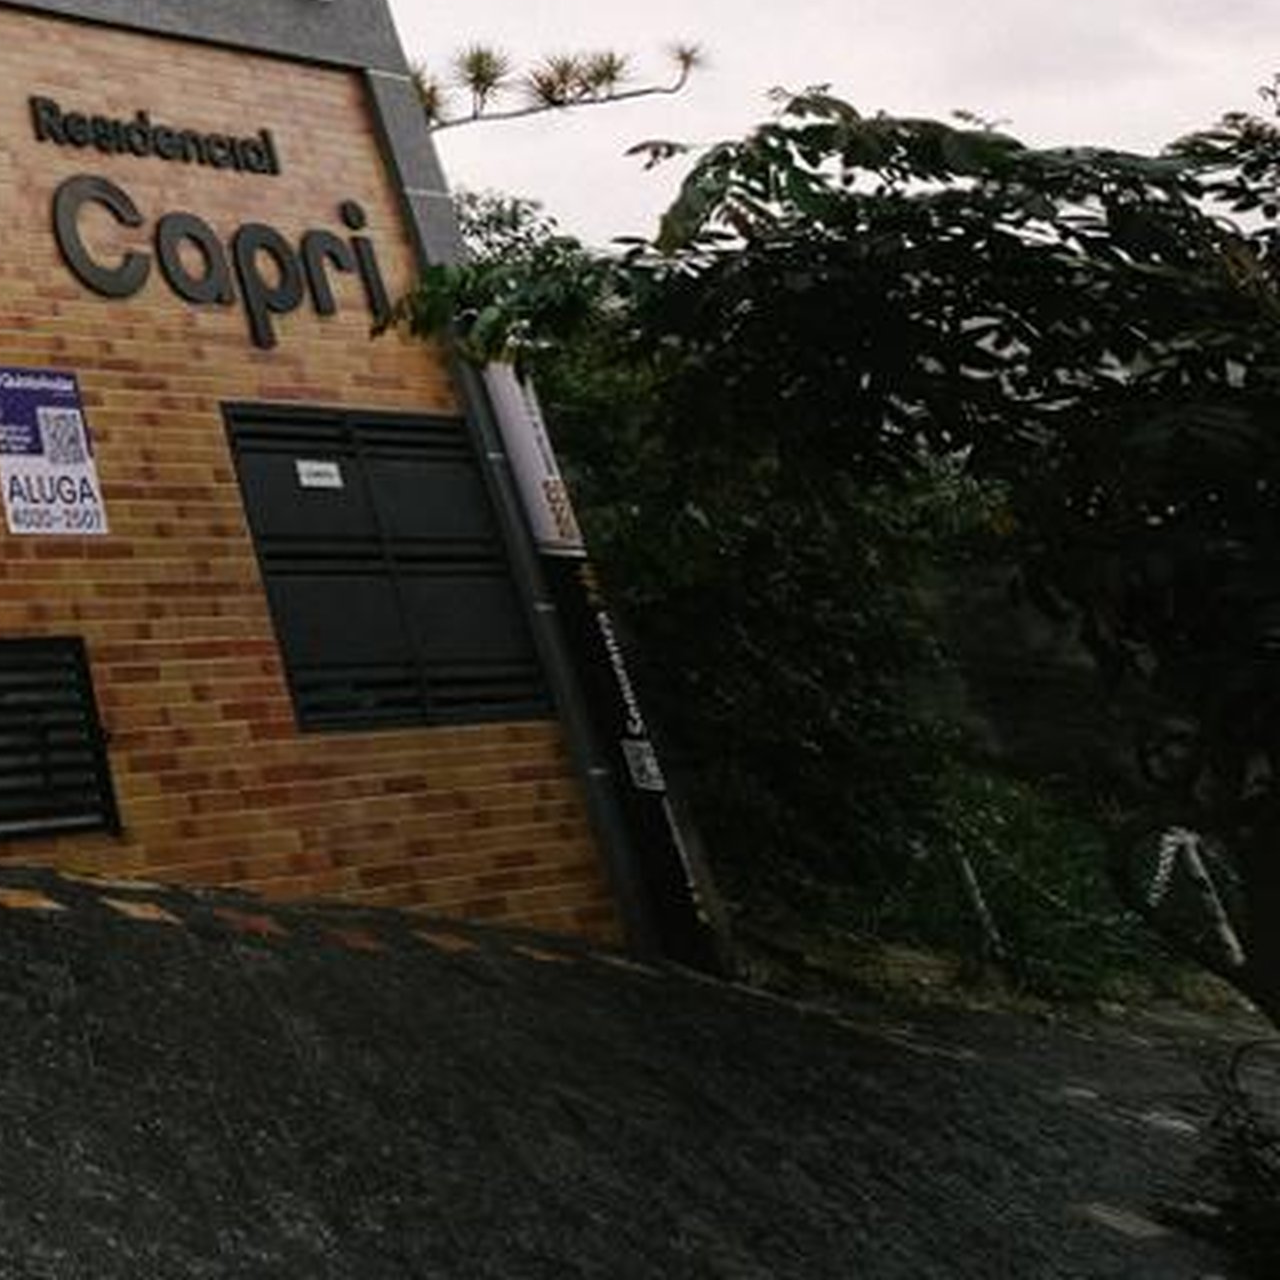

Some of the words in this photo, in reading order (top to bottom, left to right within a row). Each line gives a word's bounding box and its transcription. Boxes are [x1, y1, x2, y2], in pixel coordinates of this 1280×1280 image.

[27, 94, 280, 176] Residencial
[52, 172, 391, 350] Capri
[8, 474, 98, 505] ALUGA
